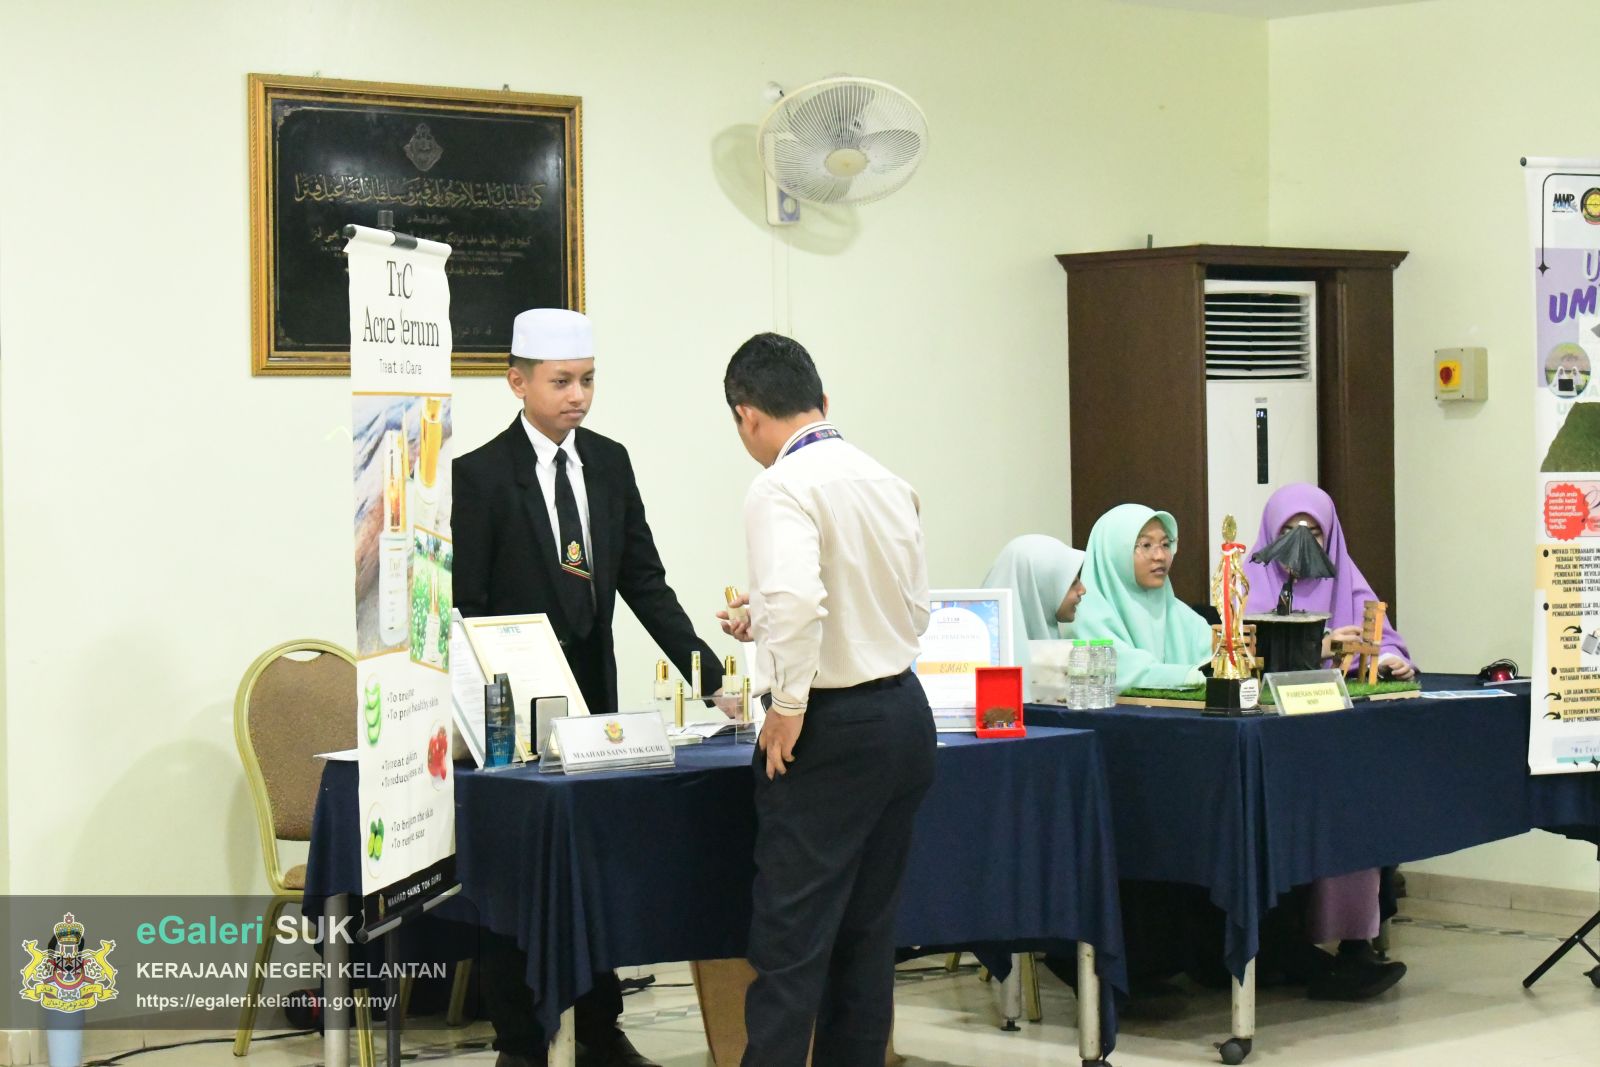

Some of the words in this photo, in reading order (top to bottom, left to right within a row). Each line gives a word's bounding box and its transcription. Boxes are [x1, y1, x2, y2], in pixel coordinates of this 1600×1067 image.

[1549, 285, 1600, 323] UM
[362, 305, 396, 344] Acne
[940, 662, 968, 673] EMAS
[572, 750, 606, 760] MAAHAD
[607, 748, 627, 757] SAINS
[629, 746, 645, 755] TOK
[645, 744, 665, 754] GURU
[407, 884, 421, 898] SAINS
[421, 879, 431, 891] TOK
